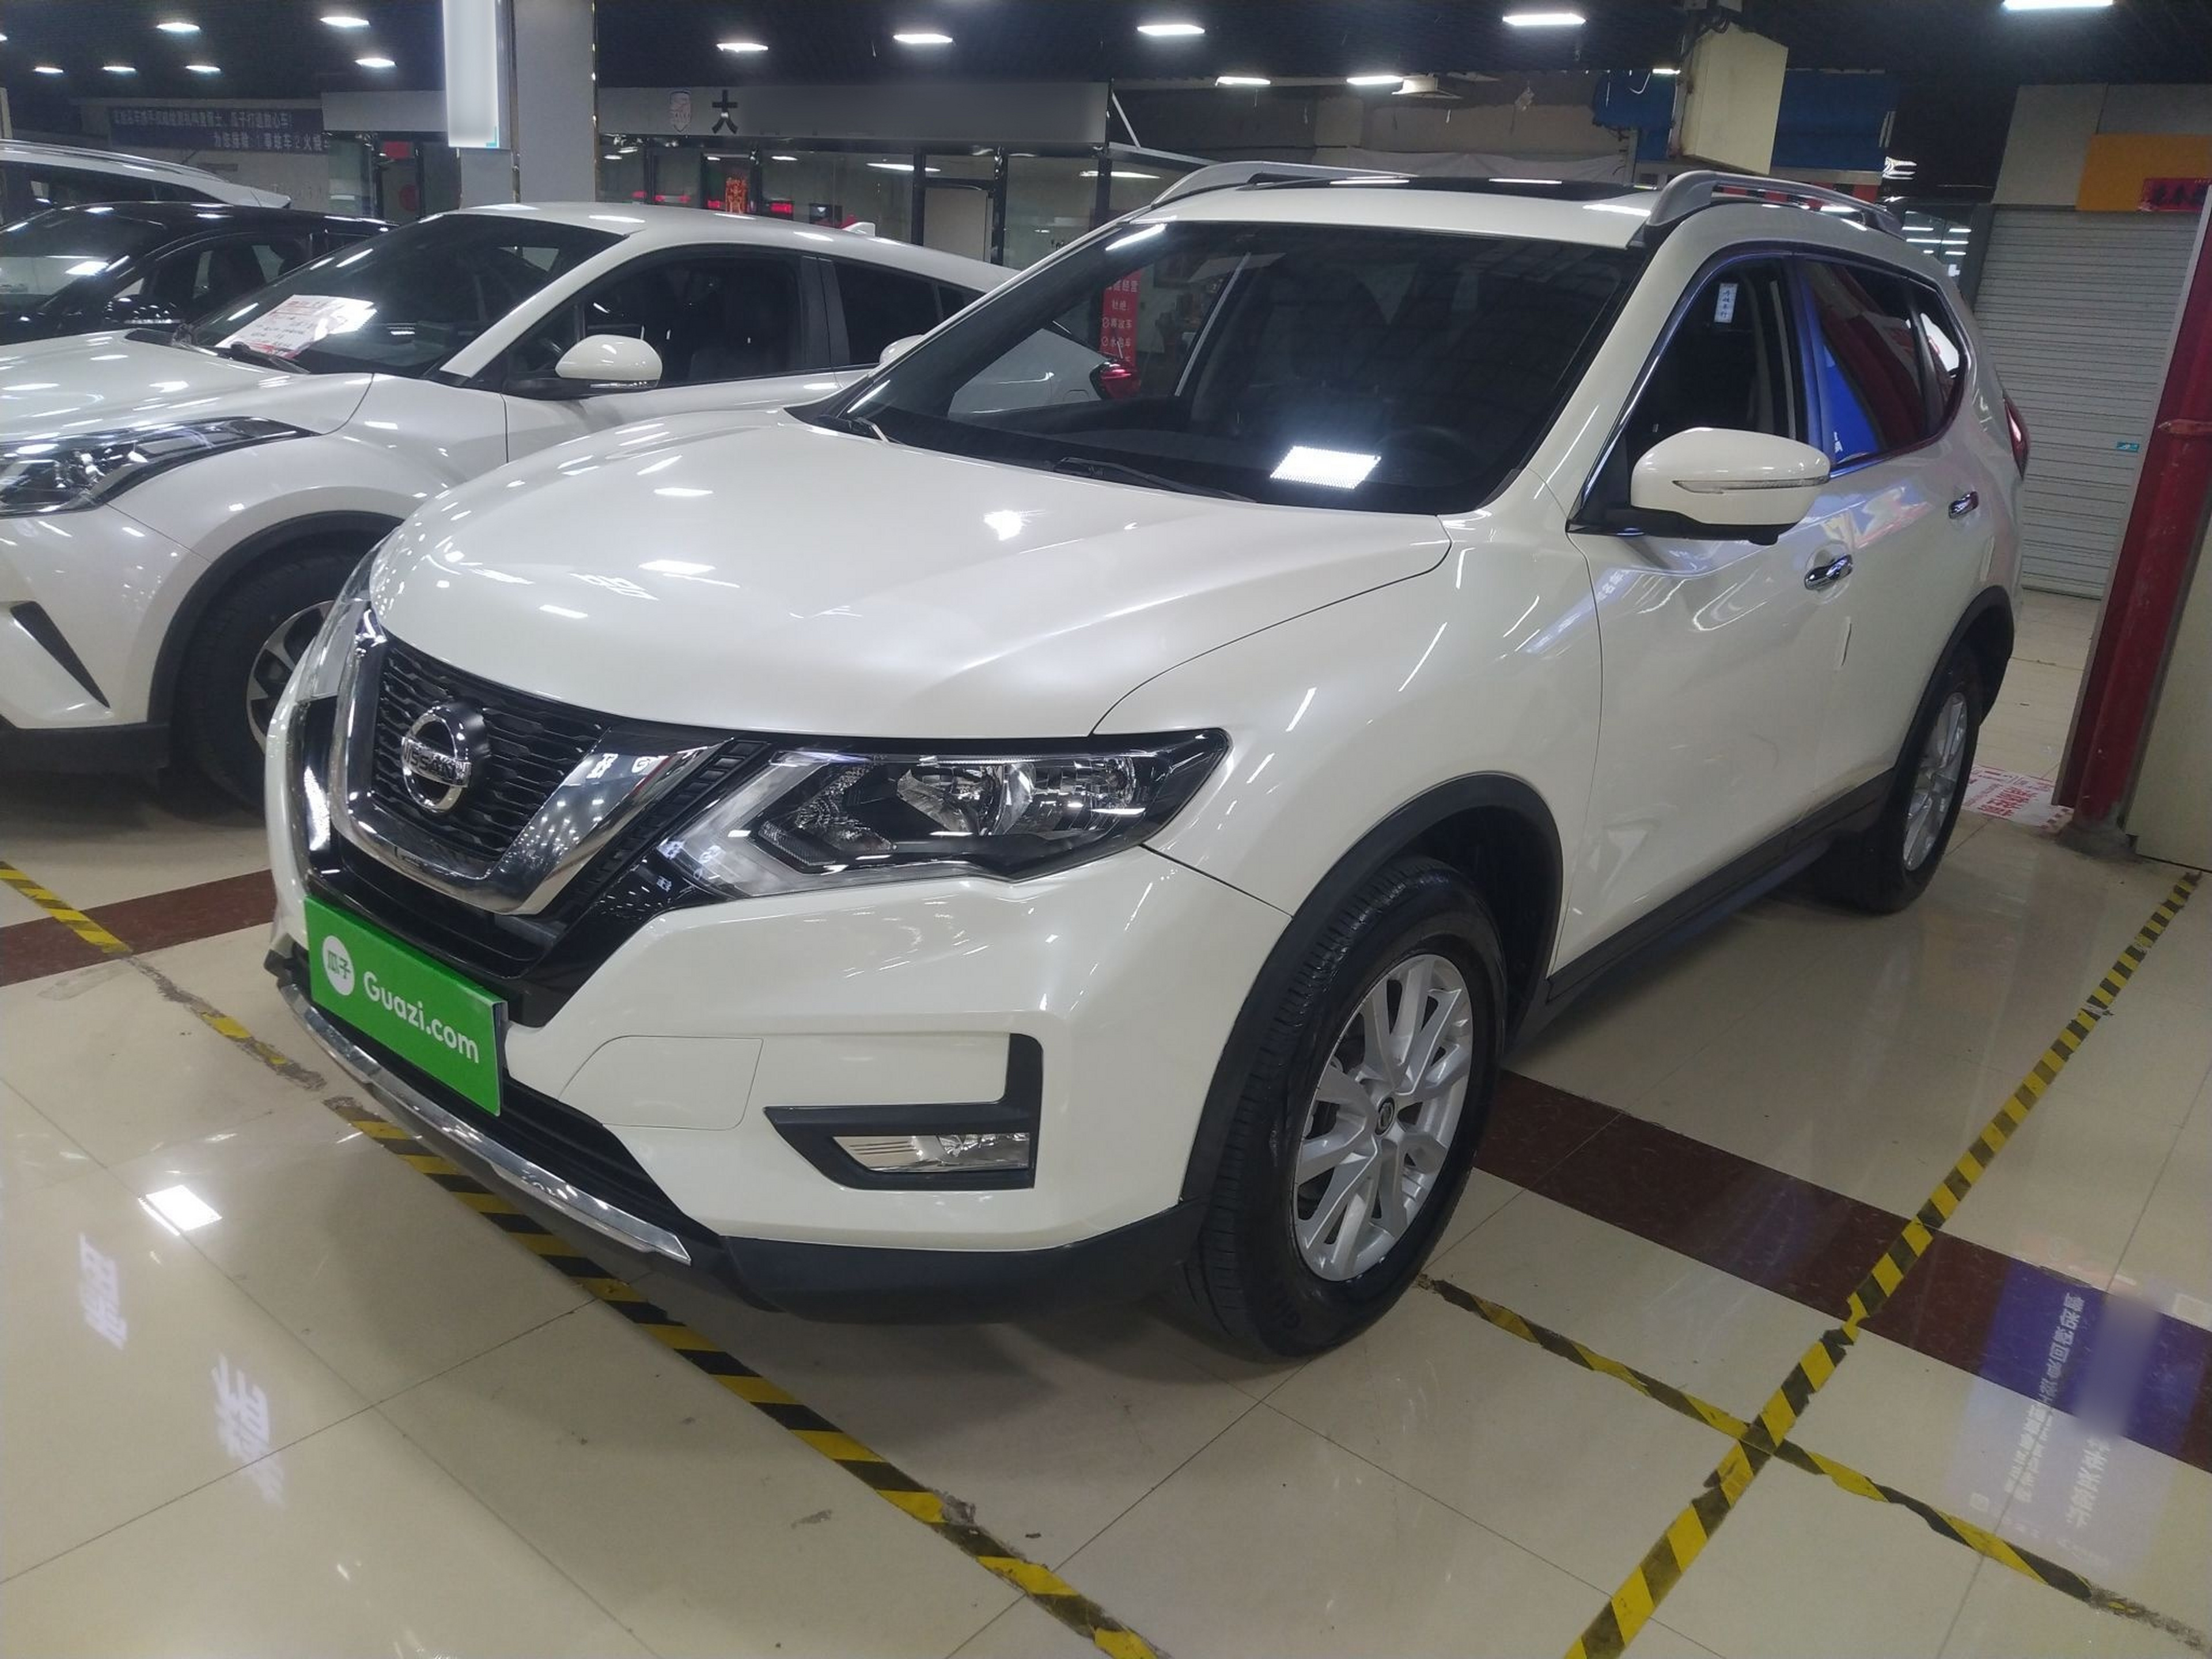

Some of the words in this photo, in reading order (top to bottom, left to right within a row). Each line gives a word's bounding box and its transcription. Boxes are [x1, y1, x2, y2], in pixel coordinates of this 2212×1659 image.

[712, 89, 738, 134] 大
[328, 950, 351, 980] 瓜子
[363, 971, 479, 1064] Guazi.com
